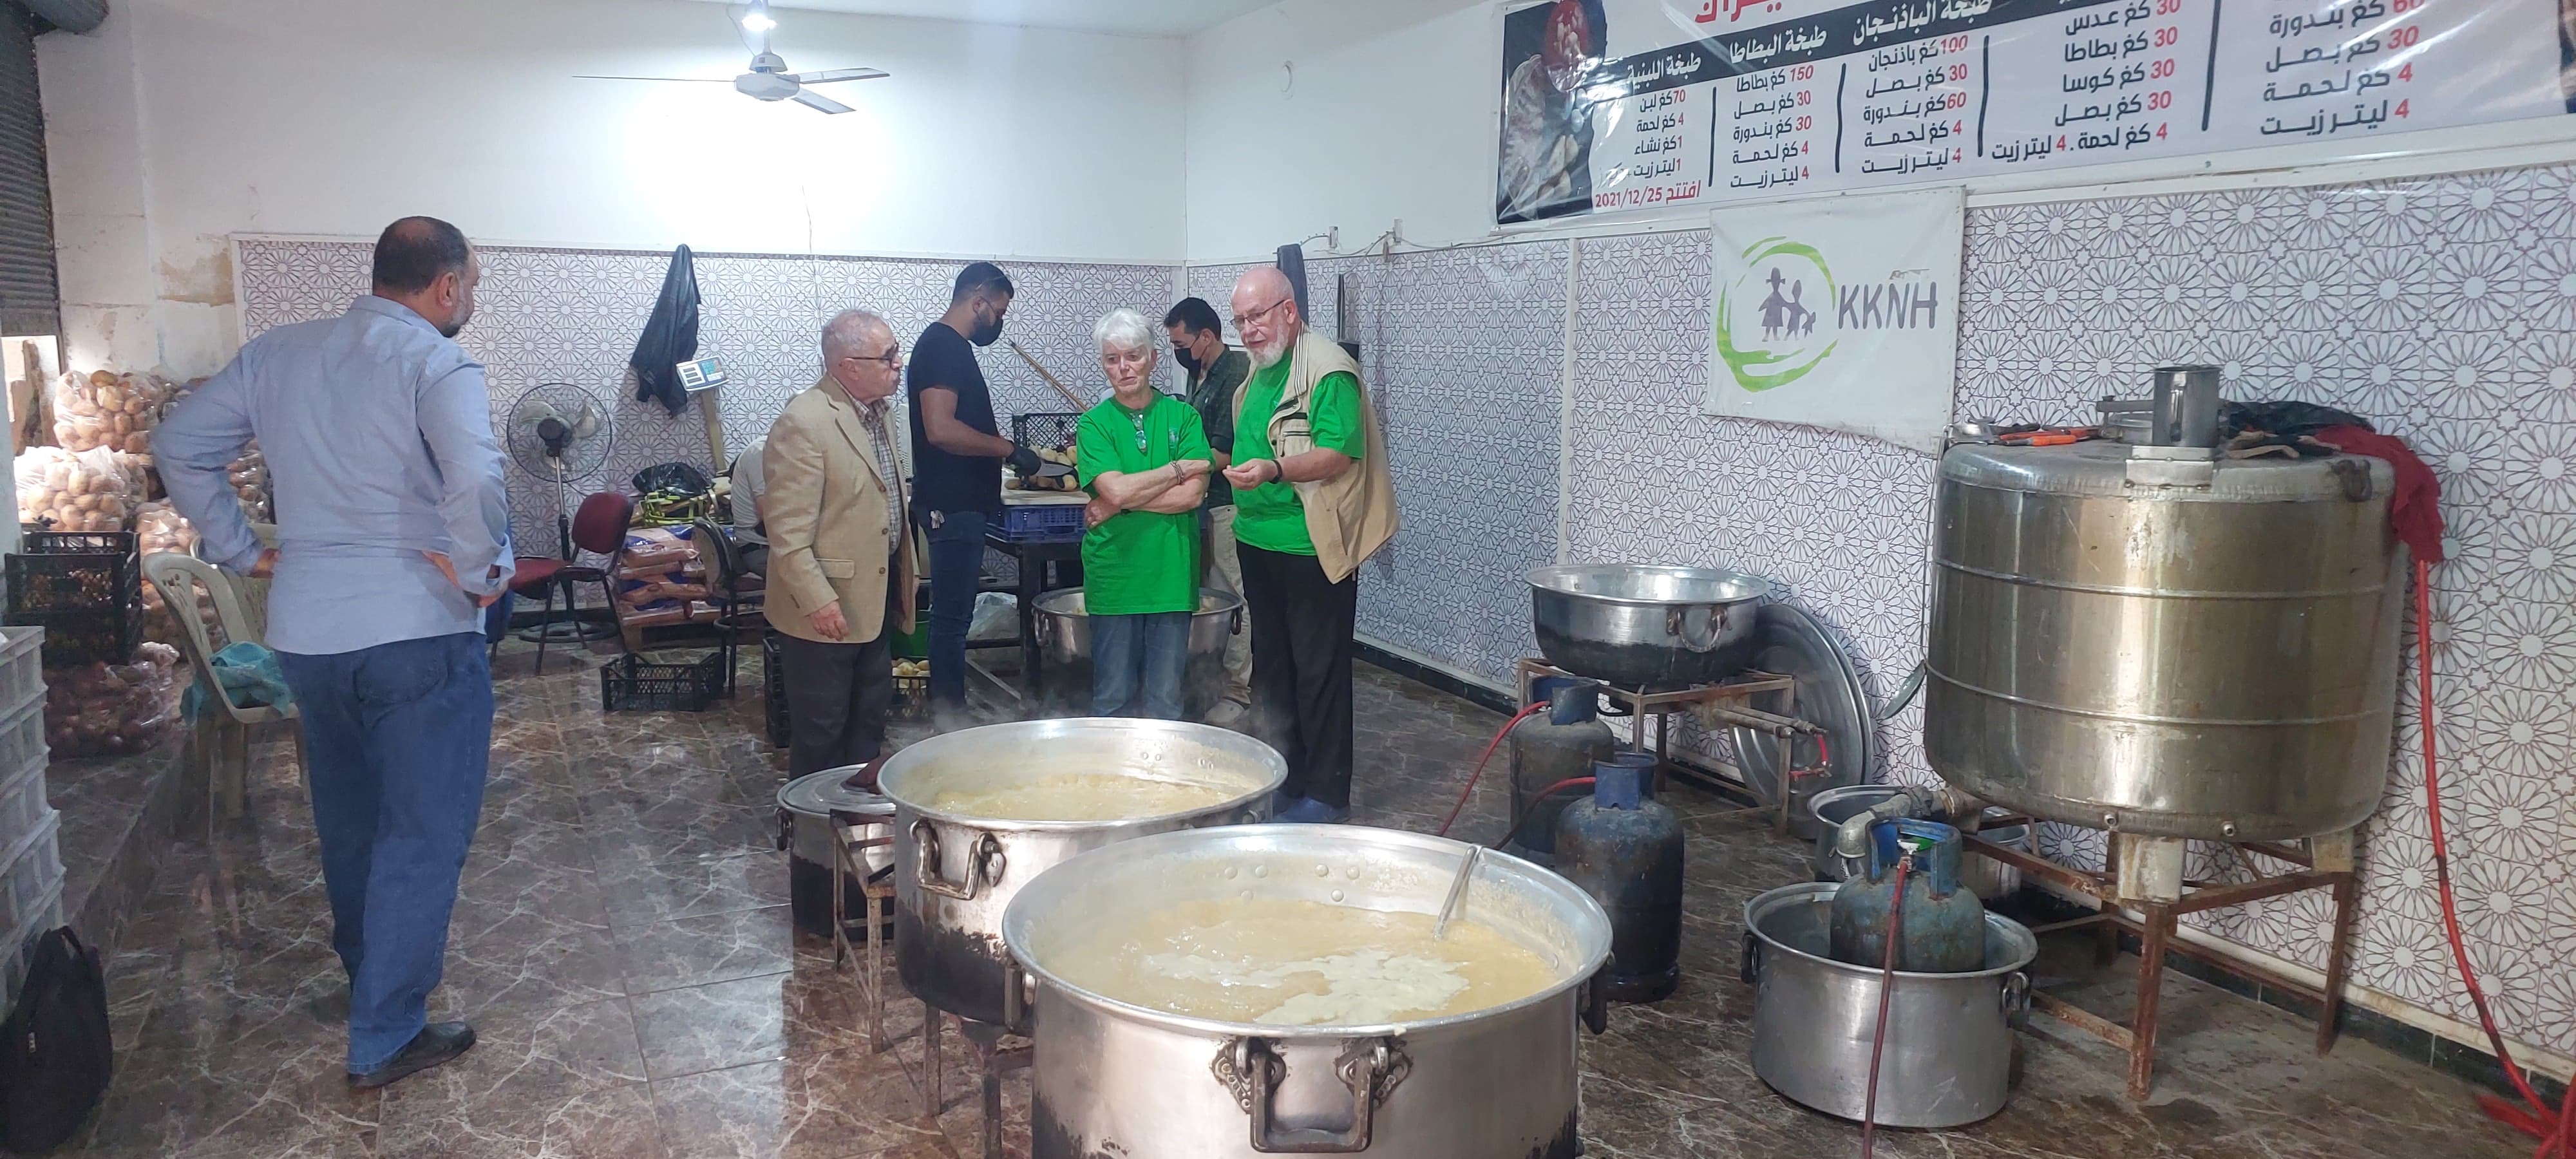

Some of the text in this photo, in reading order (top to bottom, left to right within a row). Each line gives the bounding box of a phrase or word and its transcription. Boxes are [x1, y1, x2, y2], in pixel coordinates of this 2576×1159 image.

[1853, 0, 1936, 46] الباذنجان
[2065, 10, 2119, 35] عدس
[1730, 25, 1827, 64] طبخة البطاطا
[2154, 26, 2178, 48] 30
[2387, 25, 2420, 50] 30
[1869, 45, 1915, 72] باذنجان
[2065, 38, 2117, 62] بطاطا
[1667, 52, 1701, 80] طبخة
[1790, 65, 1814, 82] 150
[1949, 64, 1967, 81] 30
[2150, 58, 2175, 79] 30
[2398, 62, 2412, 82] 4
[1737, 73, 1768, 92] بطاطا
[2063, 66, 2114, 93] كوسا
[1640, 93, 1656, 113] لبن
[1797, 90, 1811, 106] 30
[2148, 90, 2172, 111] 30
[1678, 111, 1684, 126] 4
[2394, 99, 2409, 119] 4
[1637, 115, 1660, 133] لحمة
[1734, 122, 1772, 144] بندورة
[1795, 115, 1812, 131] 30
[1953, 120, 1962, 135] 4
[2156, 122, 2168, 140] 4
[1865, 124, 1924, 147] لحمة
[2056, 135, 2067, 152] 4
[1634, 137, 1661, 155] نشاء
[1733, 144, 1779, 164] لحمة
[1801, 141, 1808, 155] 4
[1953, 147, 1961, 163] 4
[1802, 166, 1809, 180] 4
[1595, 180, 1701, 209] افتتح 2021/12/25
[1839, 281, 1938, 330] KKNH
